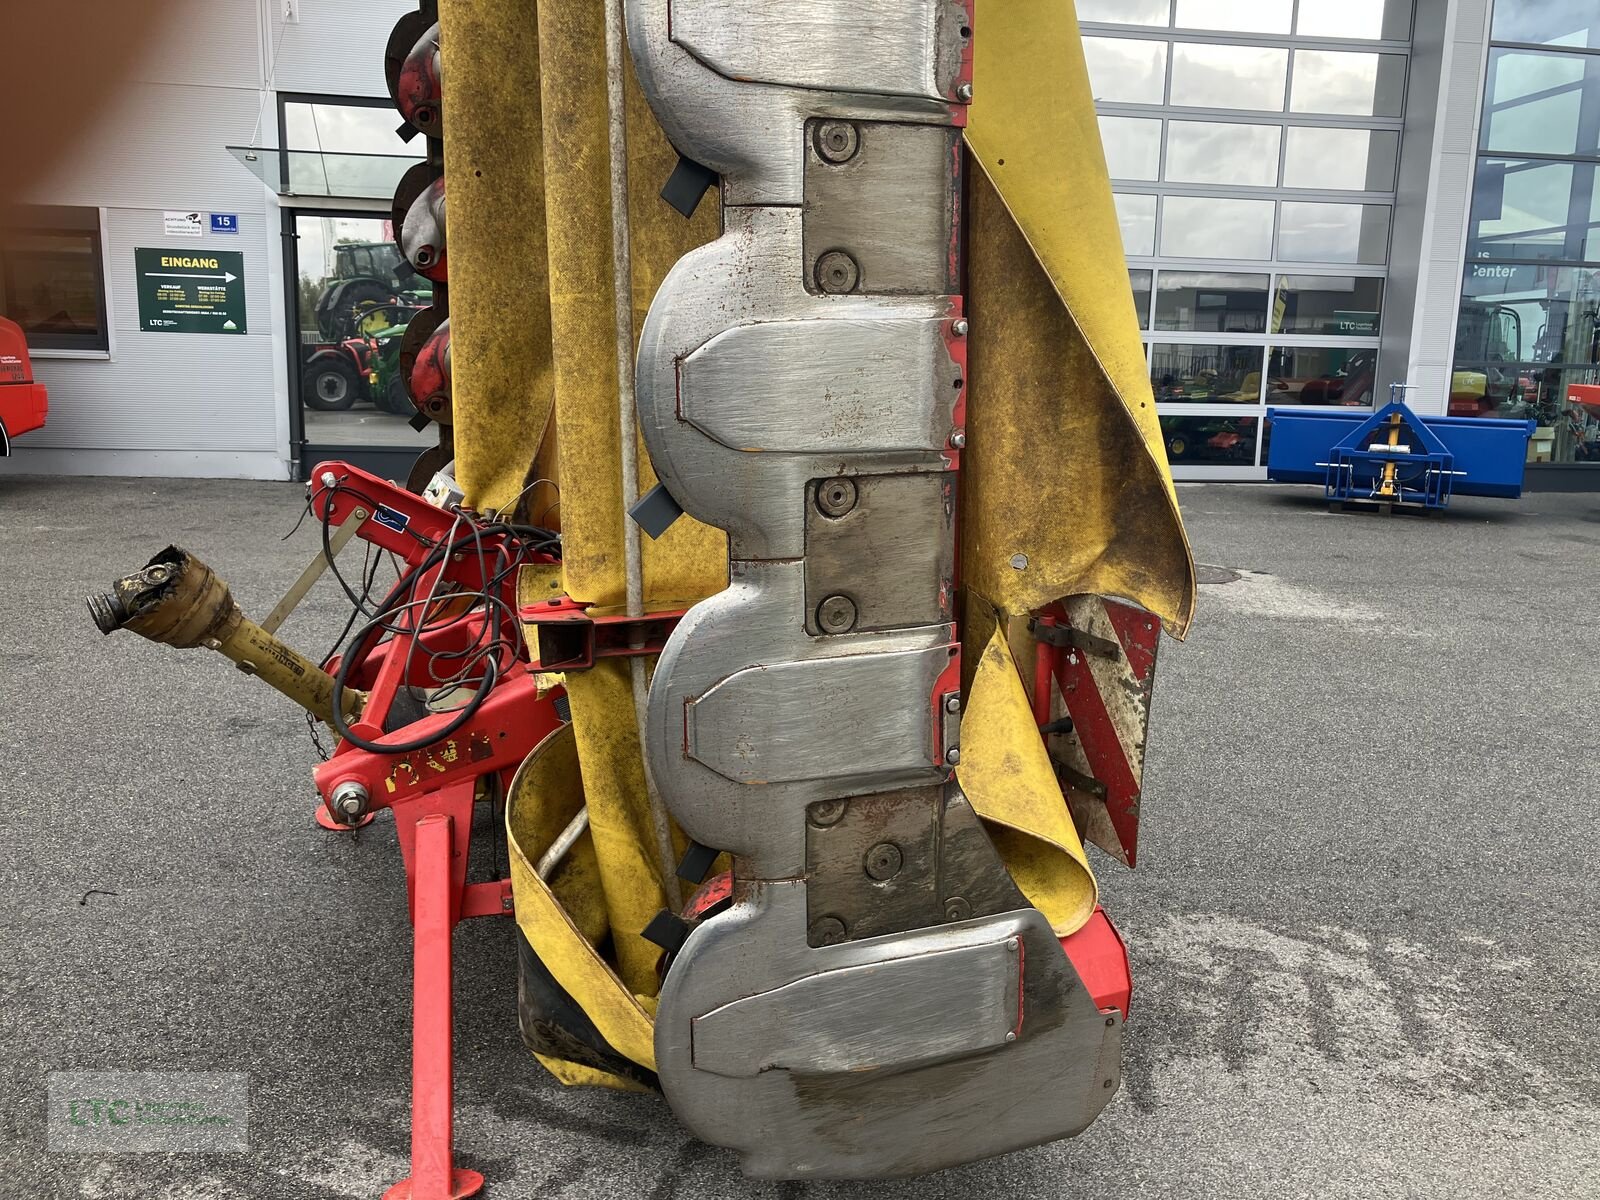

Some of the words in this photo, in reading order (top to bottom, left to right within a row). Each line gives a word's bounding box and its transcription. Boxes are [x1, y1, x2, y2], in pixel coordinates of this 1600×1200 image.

[217, 216, 231, 226] 15
[161, 257, 218, 268] EINGANG
[1340, 321, 1356, 330] LTC
